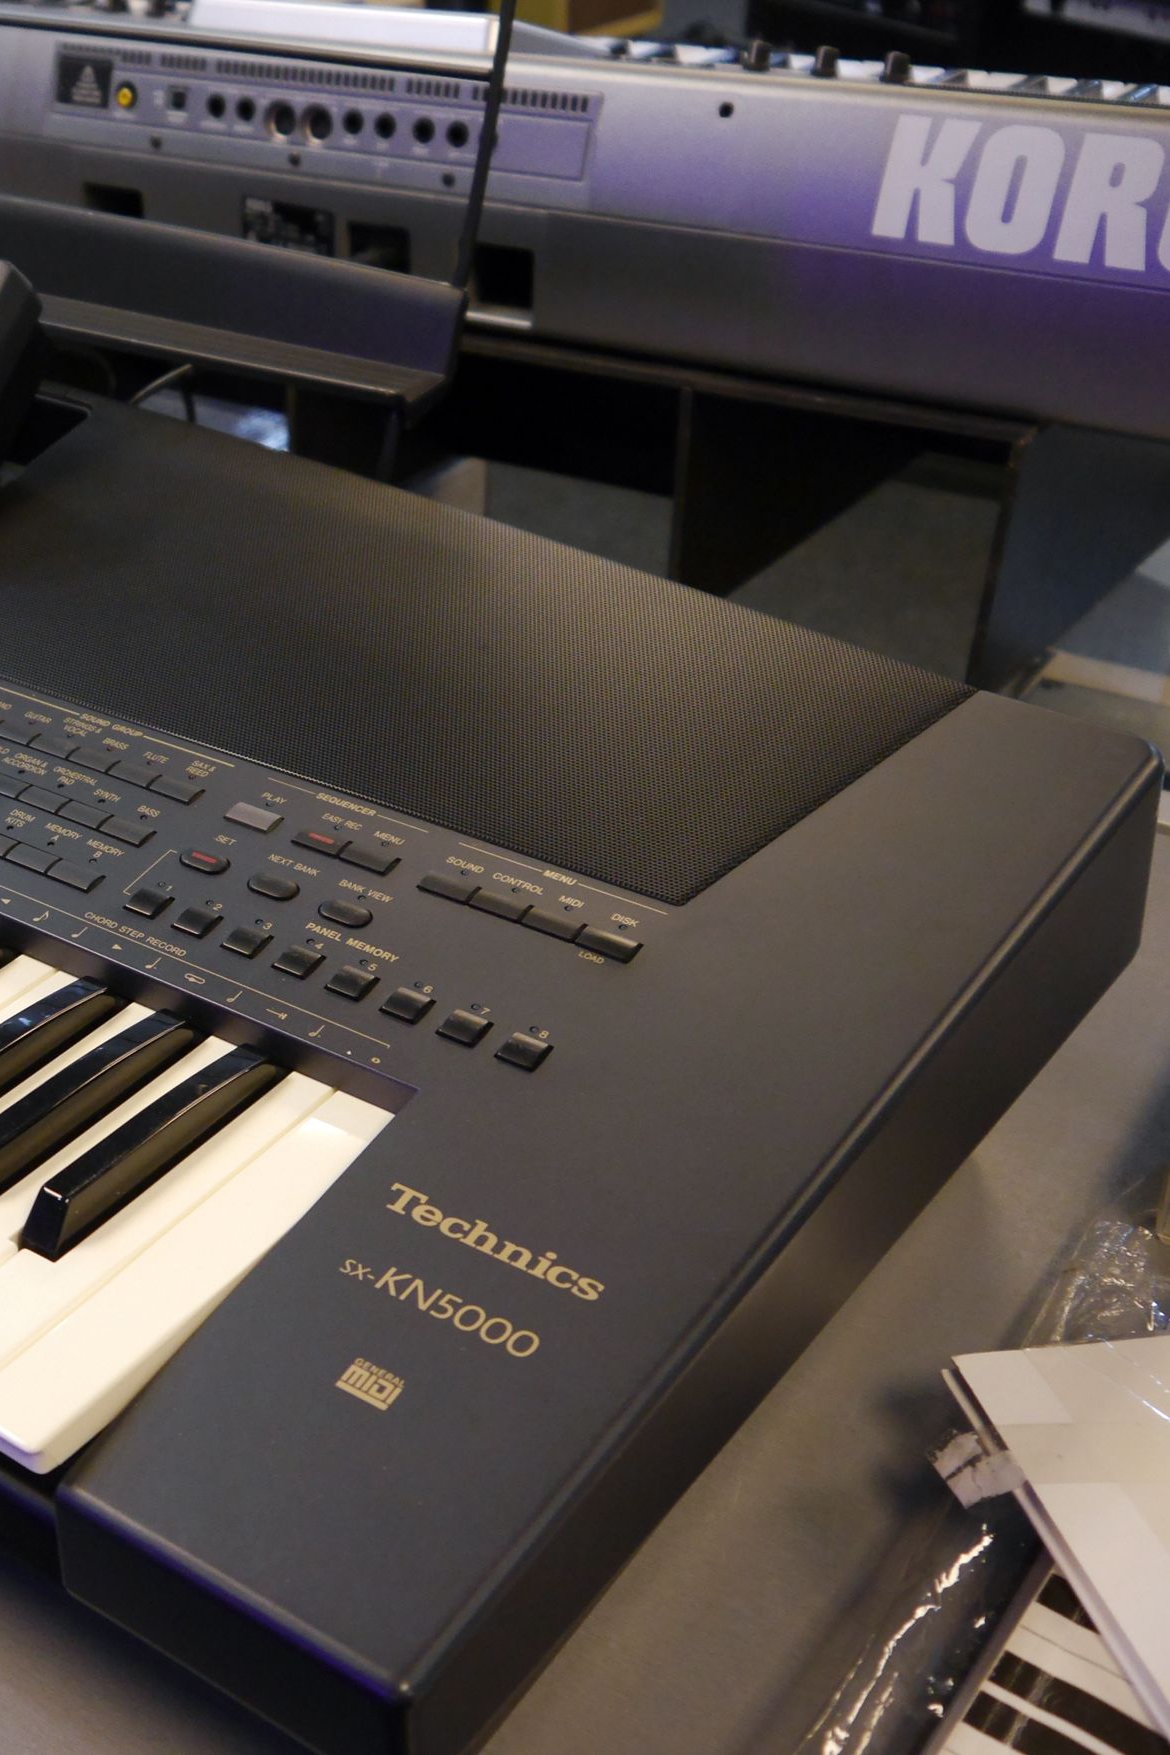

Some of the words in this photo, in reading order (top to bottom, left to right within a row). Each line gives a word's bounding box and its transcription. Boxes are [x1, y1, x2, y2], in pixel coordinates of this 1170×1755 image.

[871, 114, 1170, 272] KOR
[24, 711, 53, 724] GUITAR
[80, 713, 111, 727] SOUND
[111, 723, 143, 737] GROUP
[63, 725, 89, 737] VOCAL
[102, 737, 130, 751] BRASS
[142, 751, 170, 764] FLUTE
[185, 766, 210, 778] REED
[57, 776, 75, 786] PAD
[93, 789, 121, 802] SYNTH
[262, 792, 288, 805] PLAY
[136, 805, 161, 818] BASS
[316, 793, 377, 817] SEQUENCER
[4, 816, 26, 828] KITS
[9, 809, 36, 823] DRUM
[321, 813, 342, 825] EASY
[344, 820, 363, 831] REC
[44, 822, 83, 840] MEMORY
[374, 831, 405, 846] MENU
[86, 838, 125, 857] MEMORY
[214, 834, 238, 846] SET
[268, 853, 294, 867] NEXT
[293, 862, 321, 877] BANK
[446, 856, 485, 874] SOUND
[492, 872, 544, 895] CONTROL
[542, 870, 578, 886] MENU
[338, 879, 367, 894] BANK
[367, 889, 394, 904] VIEW
[558, 895, 585, 908] MIDI
[610, 913, 640, 927] DISK
[84, 911, 118, 929] CHORD
[119, 925, 145, 940] STEP
[146, 936, 187, 957] RECORD
[305, 922, 342, 942] PANEL
[345, 937, 399, 963] MEMORY
[578, 951, 605, 965] LOAD
[386, 1182, 605, 1301] Technics
[354, 1357, 405, 1388] GENERAL
